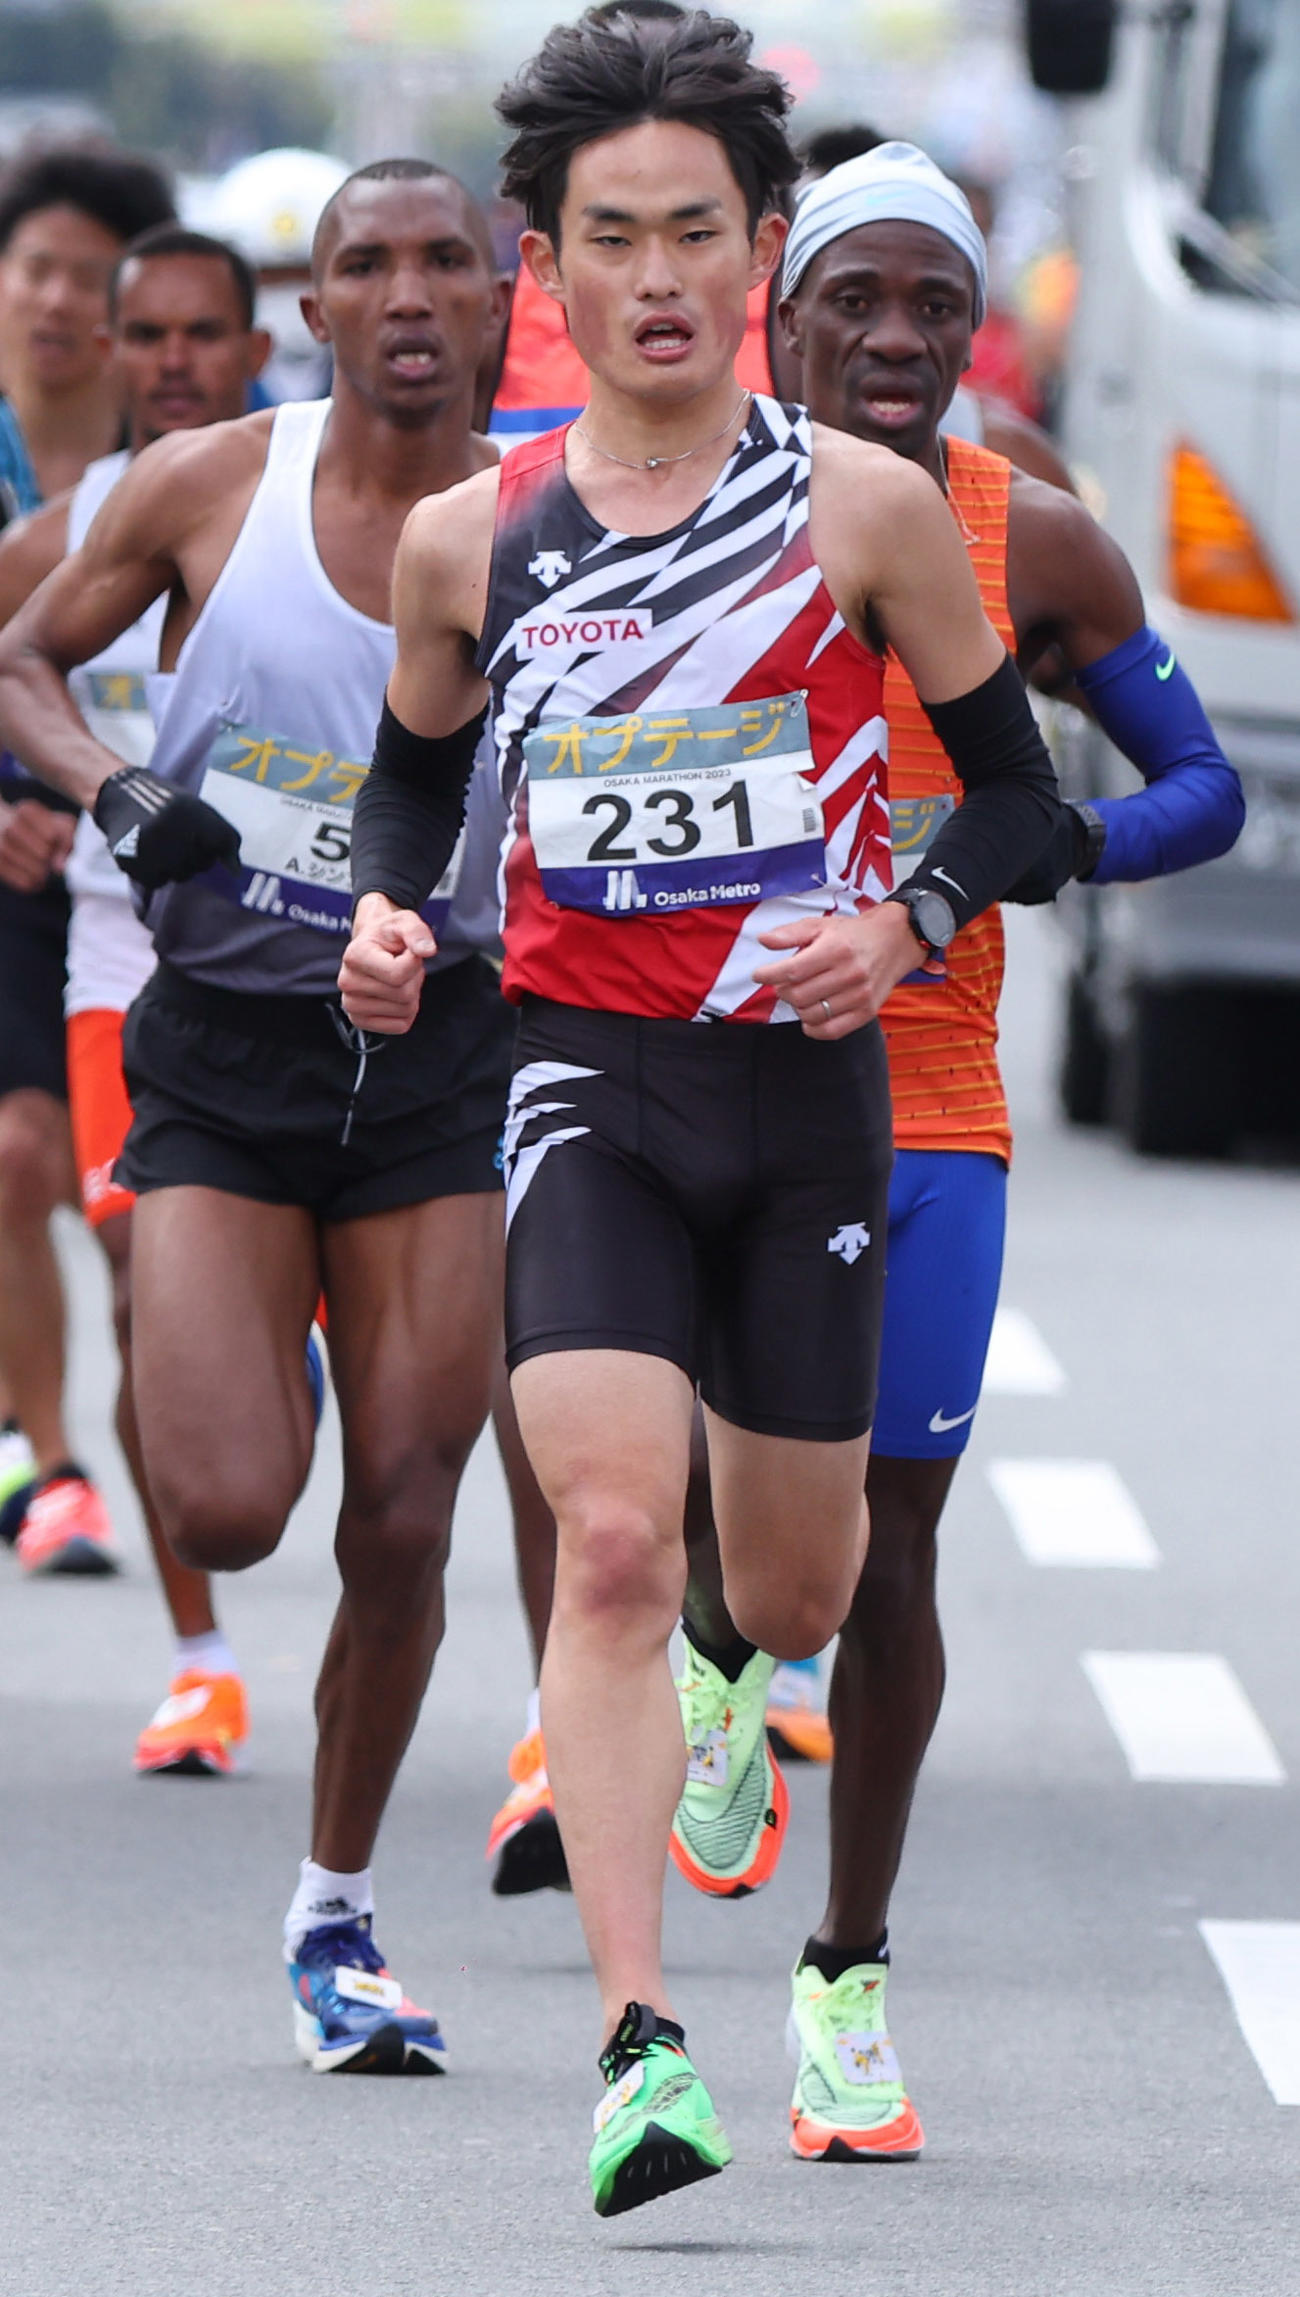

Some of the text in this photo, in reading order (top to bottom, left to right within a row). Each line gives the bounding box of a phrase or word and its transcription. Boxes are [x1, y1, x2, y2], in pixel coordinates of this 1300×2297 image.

[522, 619, 645, 648] TOYOTA
[543, 701, 786, 775] オプテージ
[603, 768, 732, 788] OSAKA MARATHON 2023
[581, 780, 755, 862] 231
[654, 883, 761, 906] Osaka Metro
[288, 903, 339, 931] Osaka
